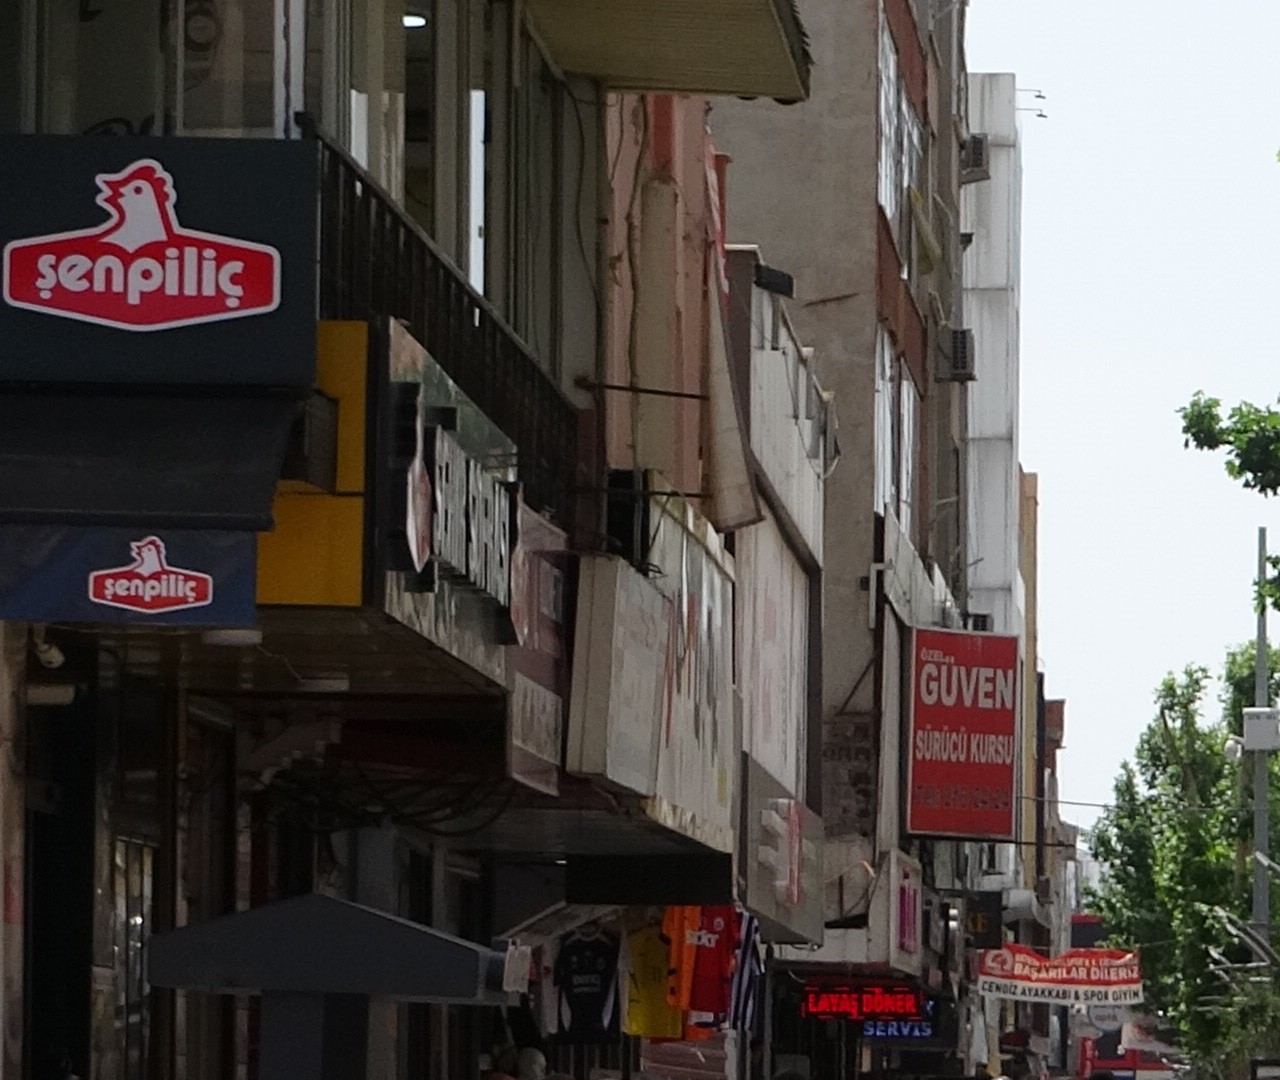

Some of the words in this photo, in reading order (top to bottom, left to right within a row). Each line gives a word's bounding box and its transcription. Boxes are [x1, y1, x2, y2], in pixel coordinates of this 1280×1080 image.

[35, 246, 245, 309] şenpiliç
[104, 574, 198, 603] şenpiliç
[919, 657, 1014, 710] GÜVEN
[915, 725, 968, 763] SÜRÜCÜ
[970, 733, 1014, 765] KURSU
[1014, 963, 1087, 981] BAŞARILAR
[1090, 964, 1139, 981] DİLERİZ
[981, 980, 1018, 996] CENGİZ
[1020, 985, 1072, 1001] AYAKKABI
[1083, 989, 1109, 1001] SPOR
